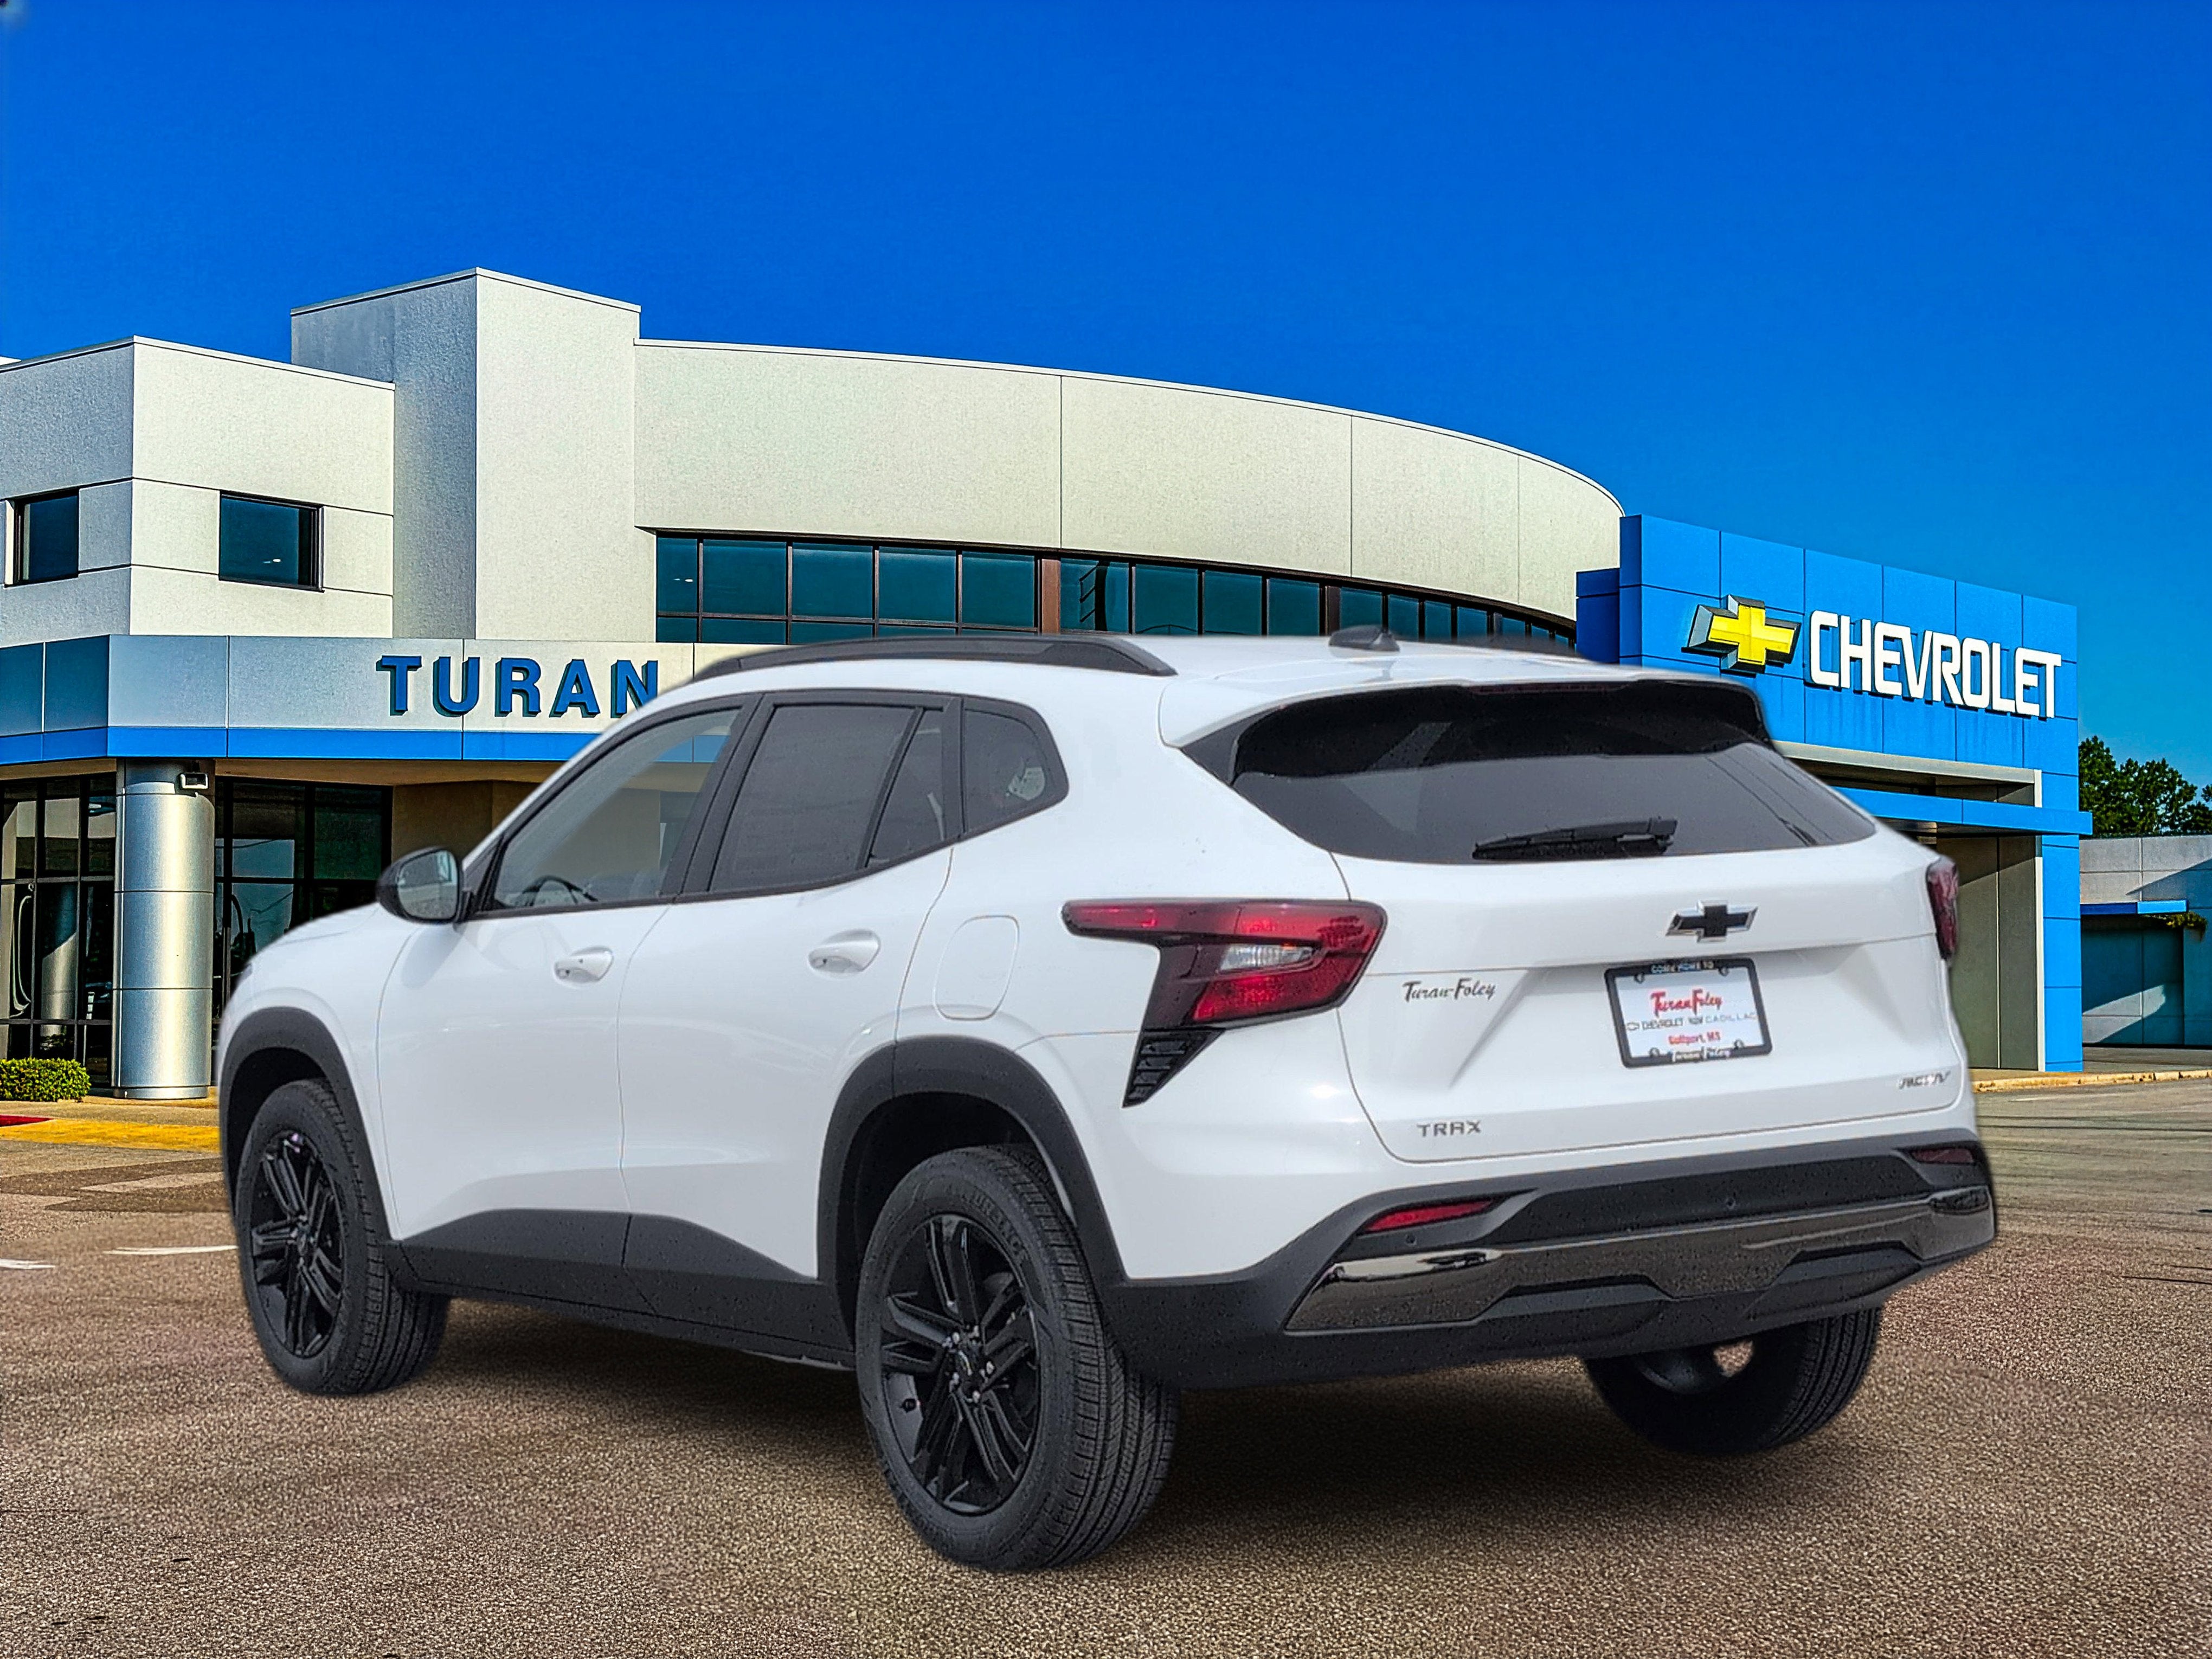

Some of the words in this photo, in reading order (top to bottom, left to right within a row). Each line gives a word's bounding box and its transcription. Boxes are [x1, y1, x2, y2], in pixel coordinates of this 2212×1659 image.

[376, 654, 659, 719] TURAN
[1810, 610, 2062, 718] CHEVROLET
[1416, 1120, 1481, 1137] TRAX
